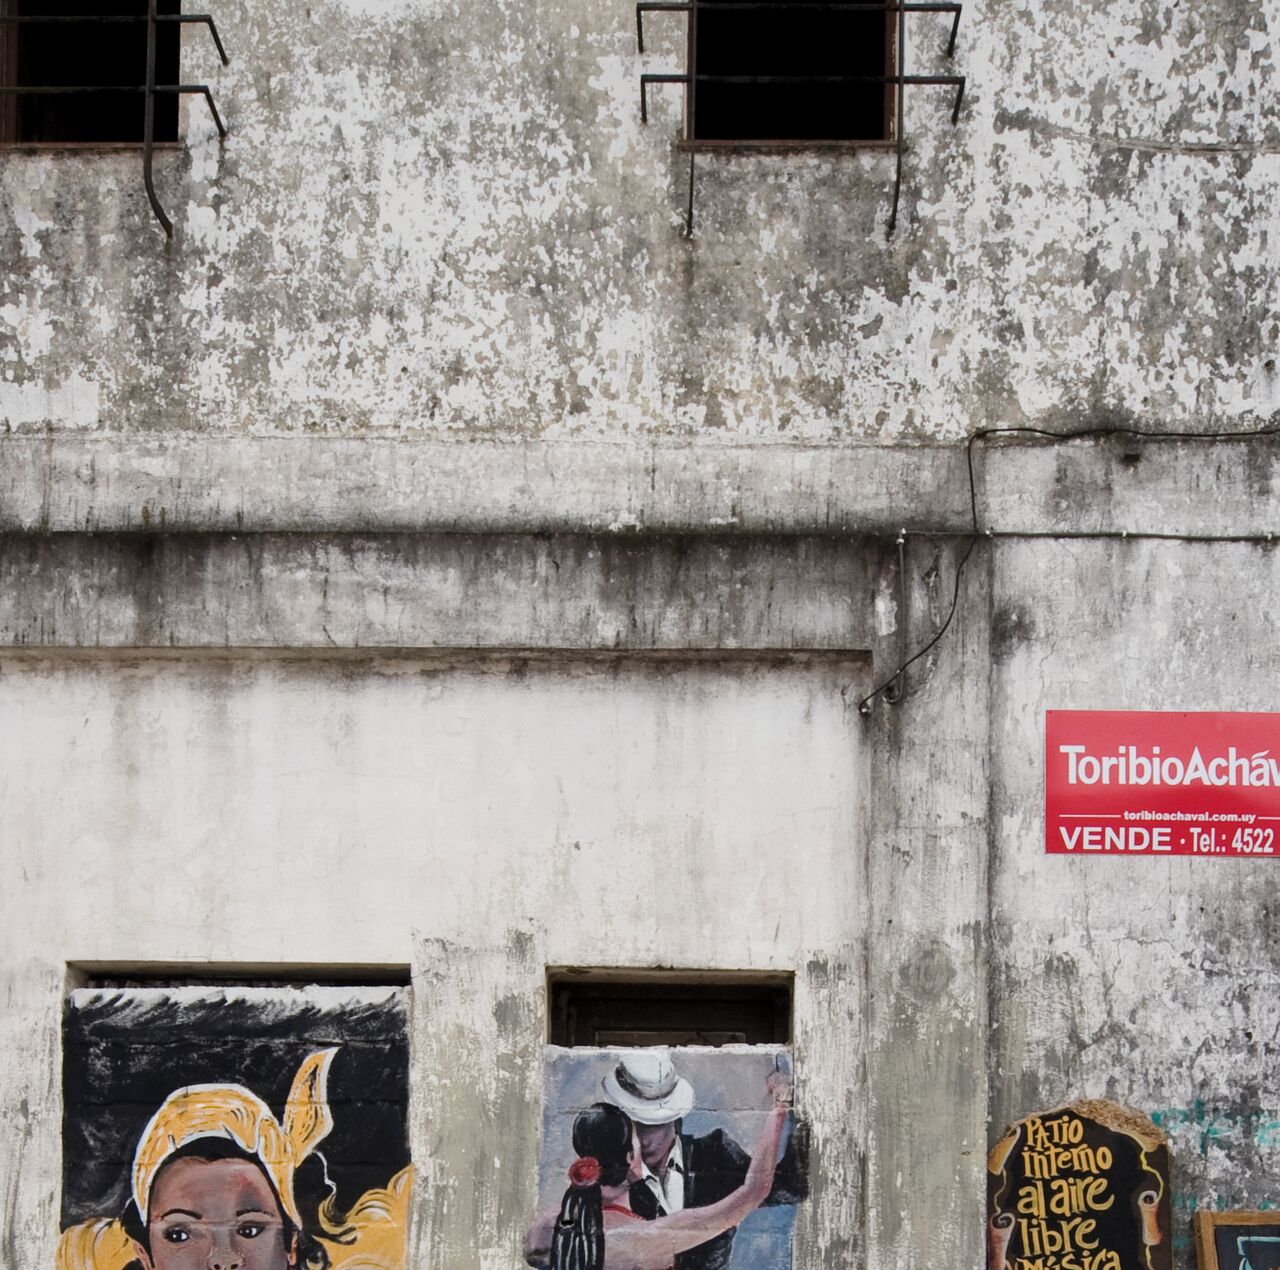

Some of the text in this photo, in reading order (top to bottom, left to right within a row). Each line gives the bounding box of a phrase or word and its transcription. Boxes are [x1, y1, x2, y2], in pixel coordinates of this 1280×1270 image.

[1123, 810, 1257, 824] toribioachaval.com.uy
[1059, 826, 1172, 851] VENDE
[1189, 827, 1226, 852] Tel.:
[1231, 828, 1274, 853] 4522
[1022, 1143, 1113, 1180] interno
[1017, 1176, 1115, 1218] al aire
[1018, 1218, 1100, 1257] libre
